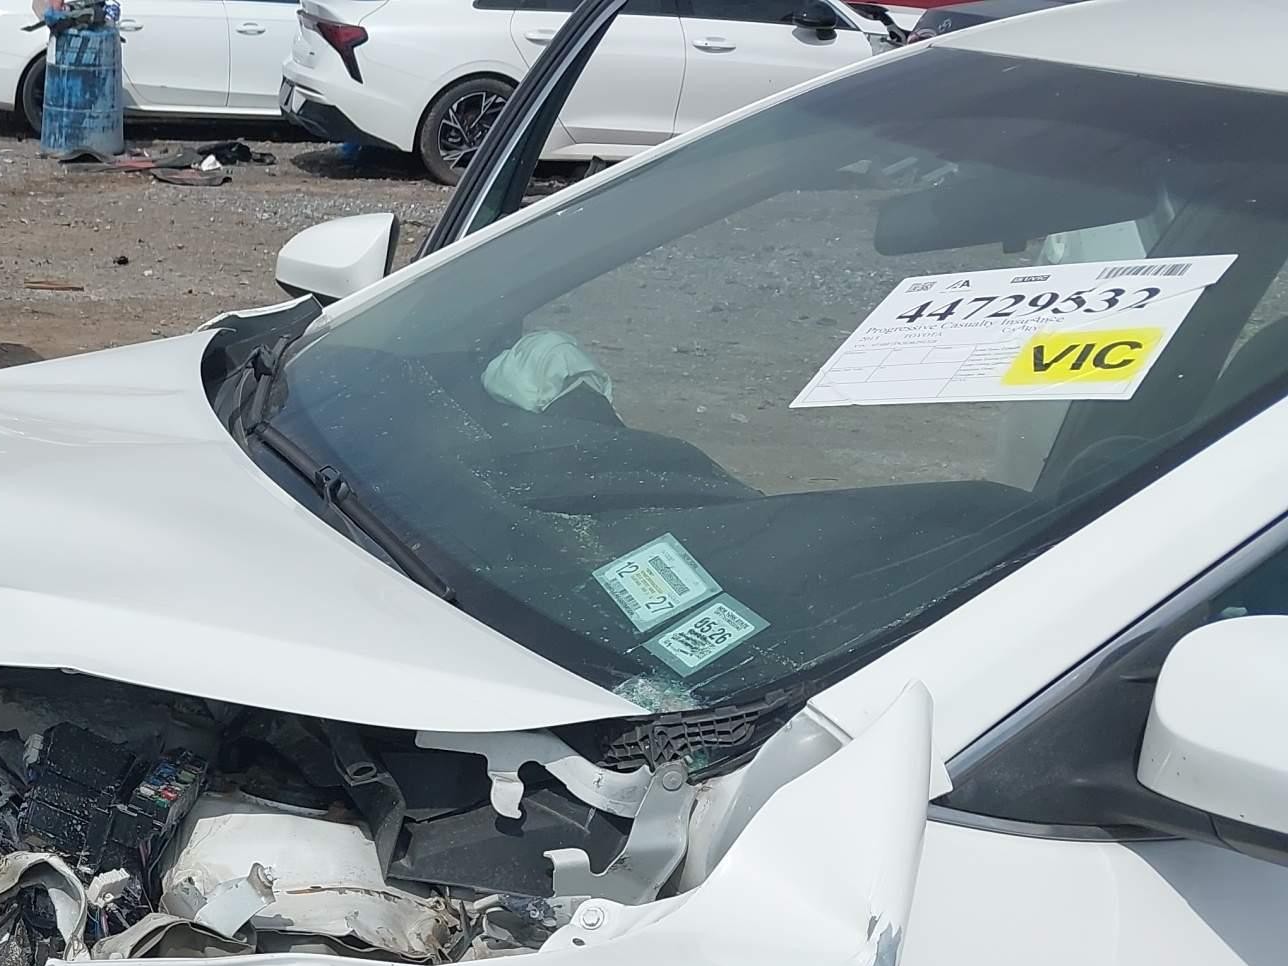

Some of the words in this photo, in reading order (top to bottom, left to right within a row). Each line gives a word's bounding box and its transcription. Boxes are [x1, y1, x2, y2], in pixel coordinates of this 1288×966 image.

[896, 286, 1161, 323] 44729532
[866, 322, 938, 335] Progressive
[940, 318, 993, 331] Casualty
[1032, 340, 1143, 372] VIC
[617, 562, 640, 578] 12
[645, 595, 675, 614] 27
